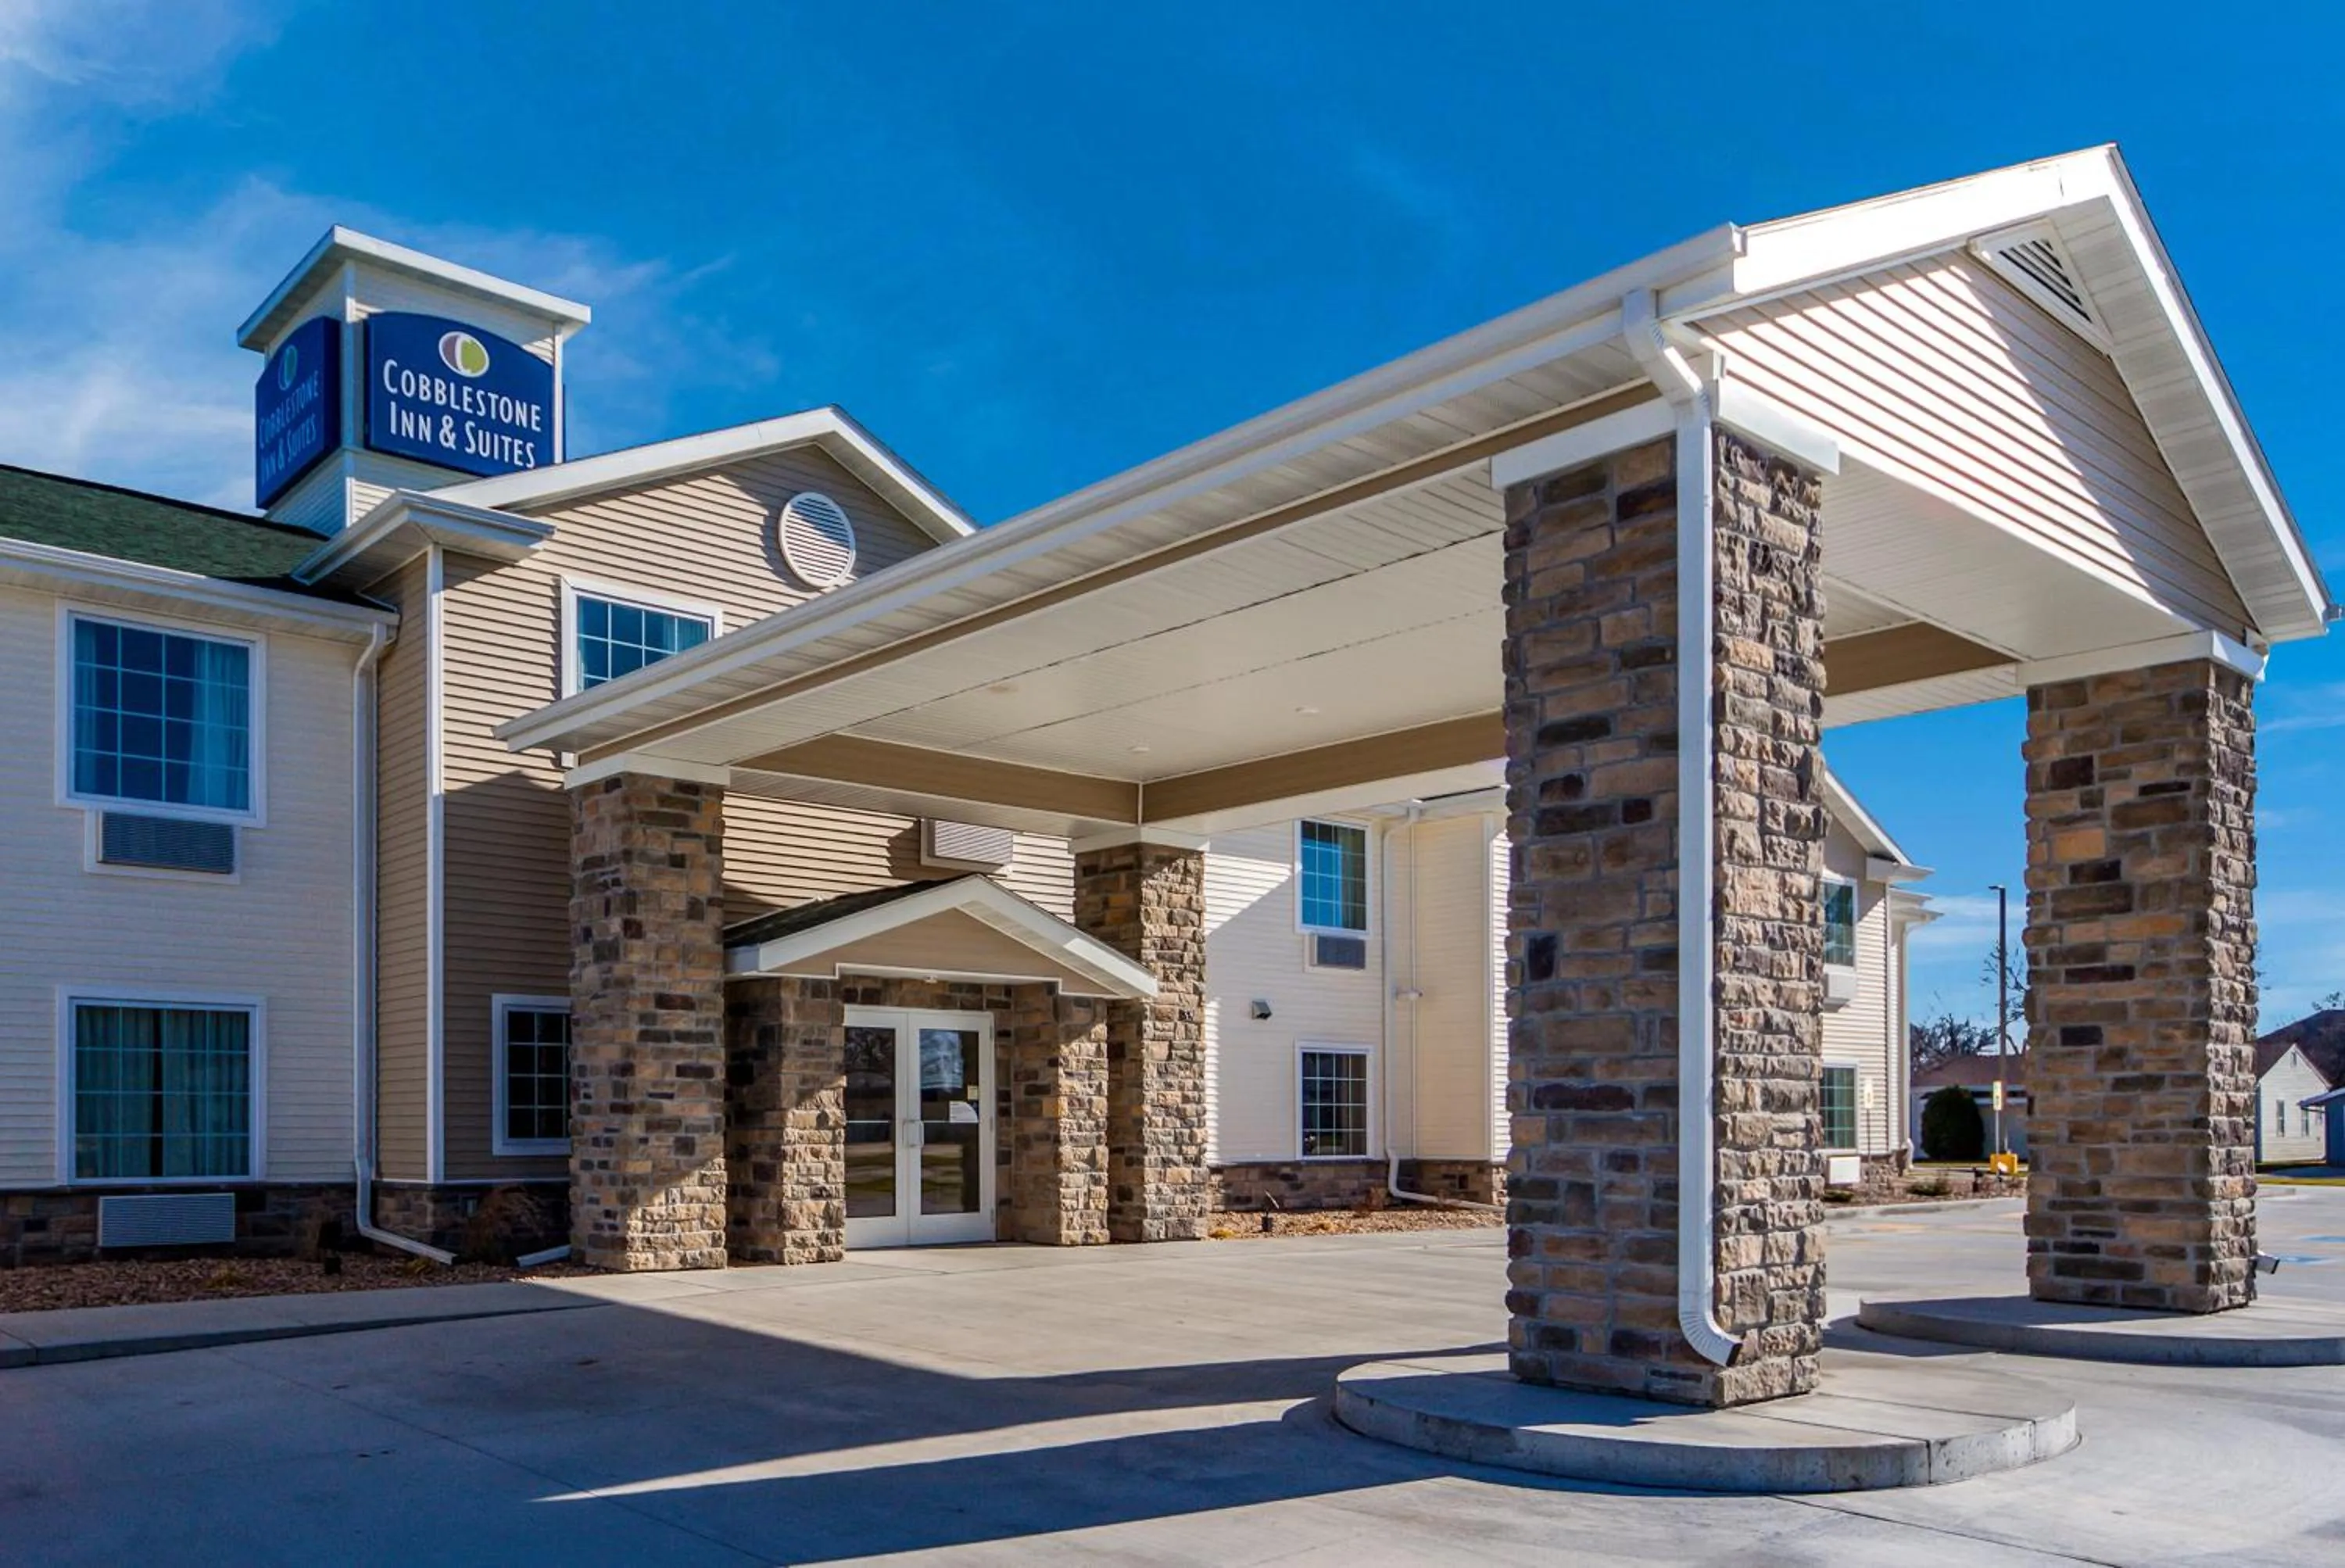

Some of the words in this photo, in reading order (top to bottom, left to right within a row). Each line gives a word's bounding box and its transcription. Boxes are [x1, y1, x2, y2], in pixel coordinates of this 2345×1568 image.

[383, 359, 542, 431] COBBLESTONE
[390, 401, 431, 443] INN
[439, 415, 456, 450] &
[464, 421, 535, 469] SUITES
